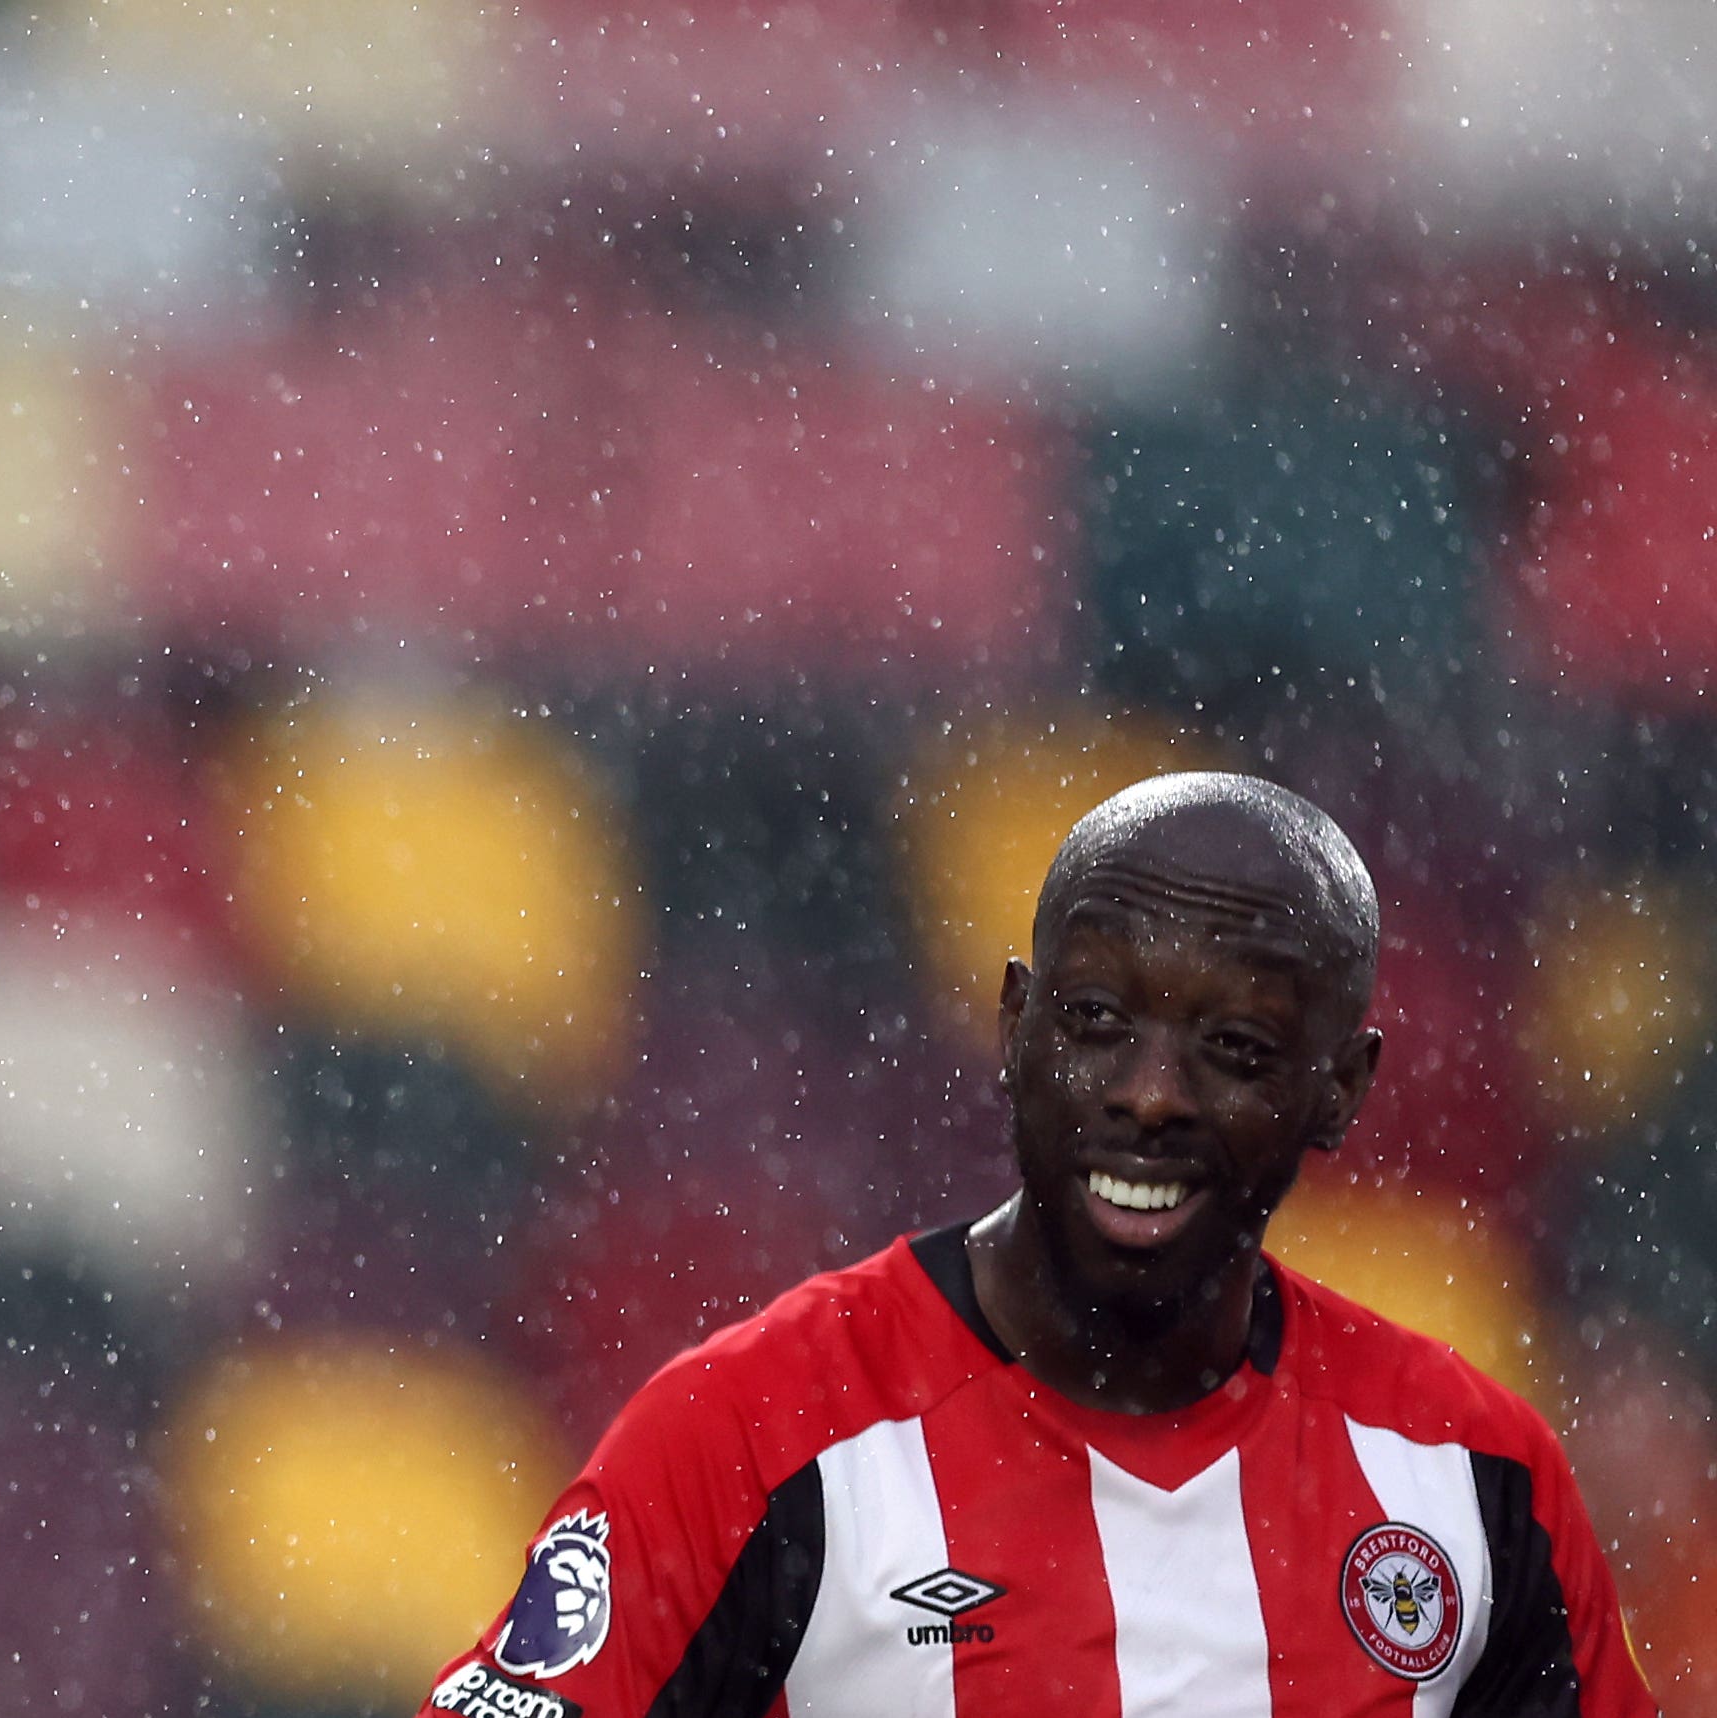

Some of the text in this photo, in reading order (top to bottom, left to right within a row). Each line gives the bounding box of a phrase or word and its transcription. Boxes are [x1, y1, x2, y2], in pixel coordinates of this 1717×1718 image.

[1354, 1534, 1440, 1571] BRENTFORD
[907, 1619, 995, 1646] umbro
[1369, 1632, 1451, 1669] FOOTBALL CLUB
